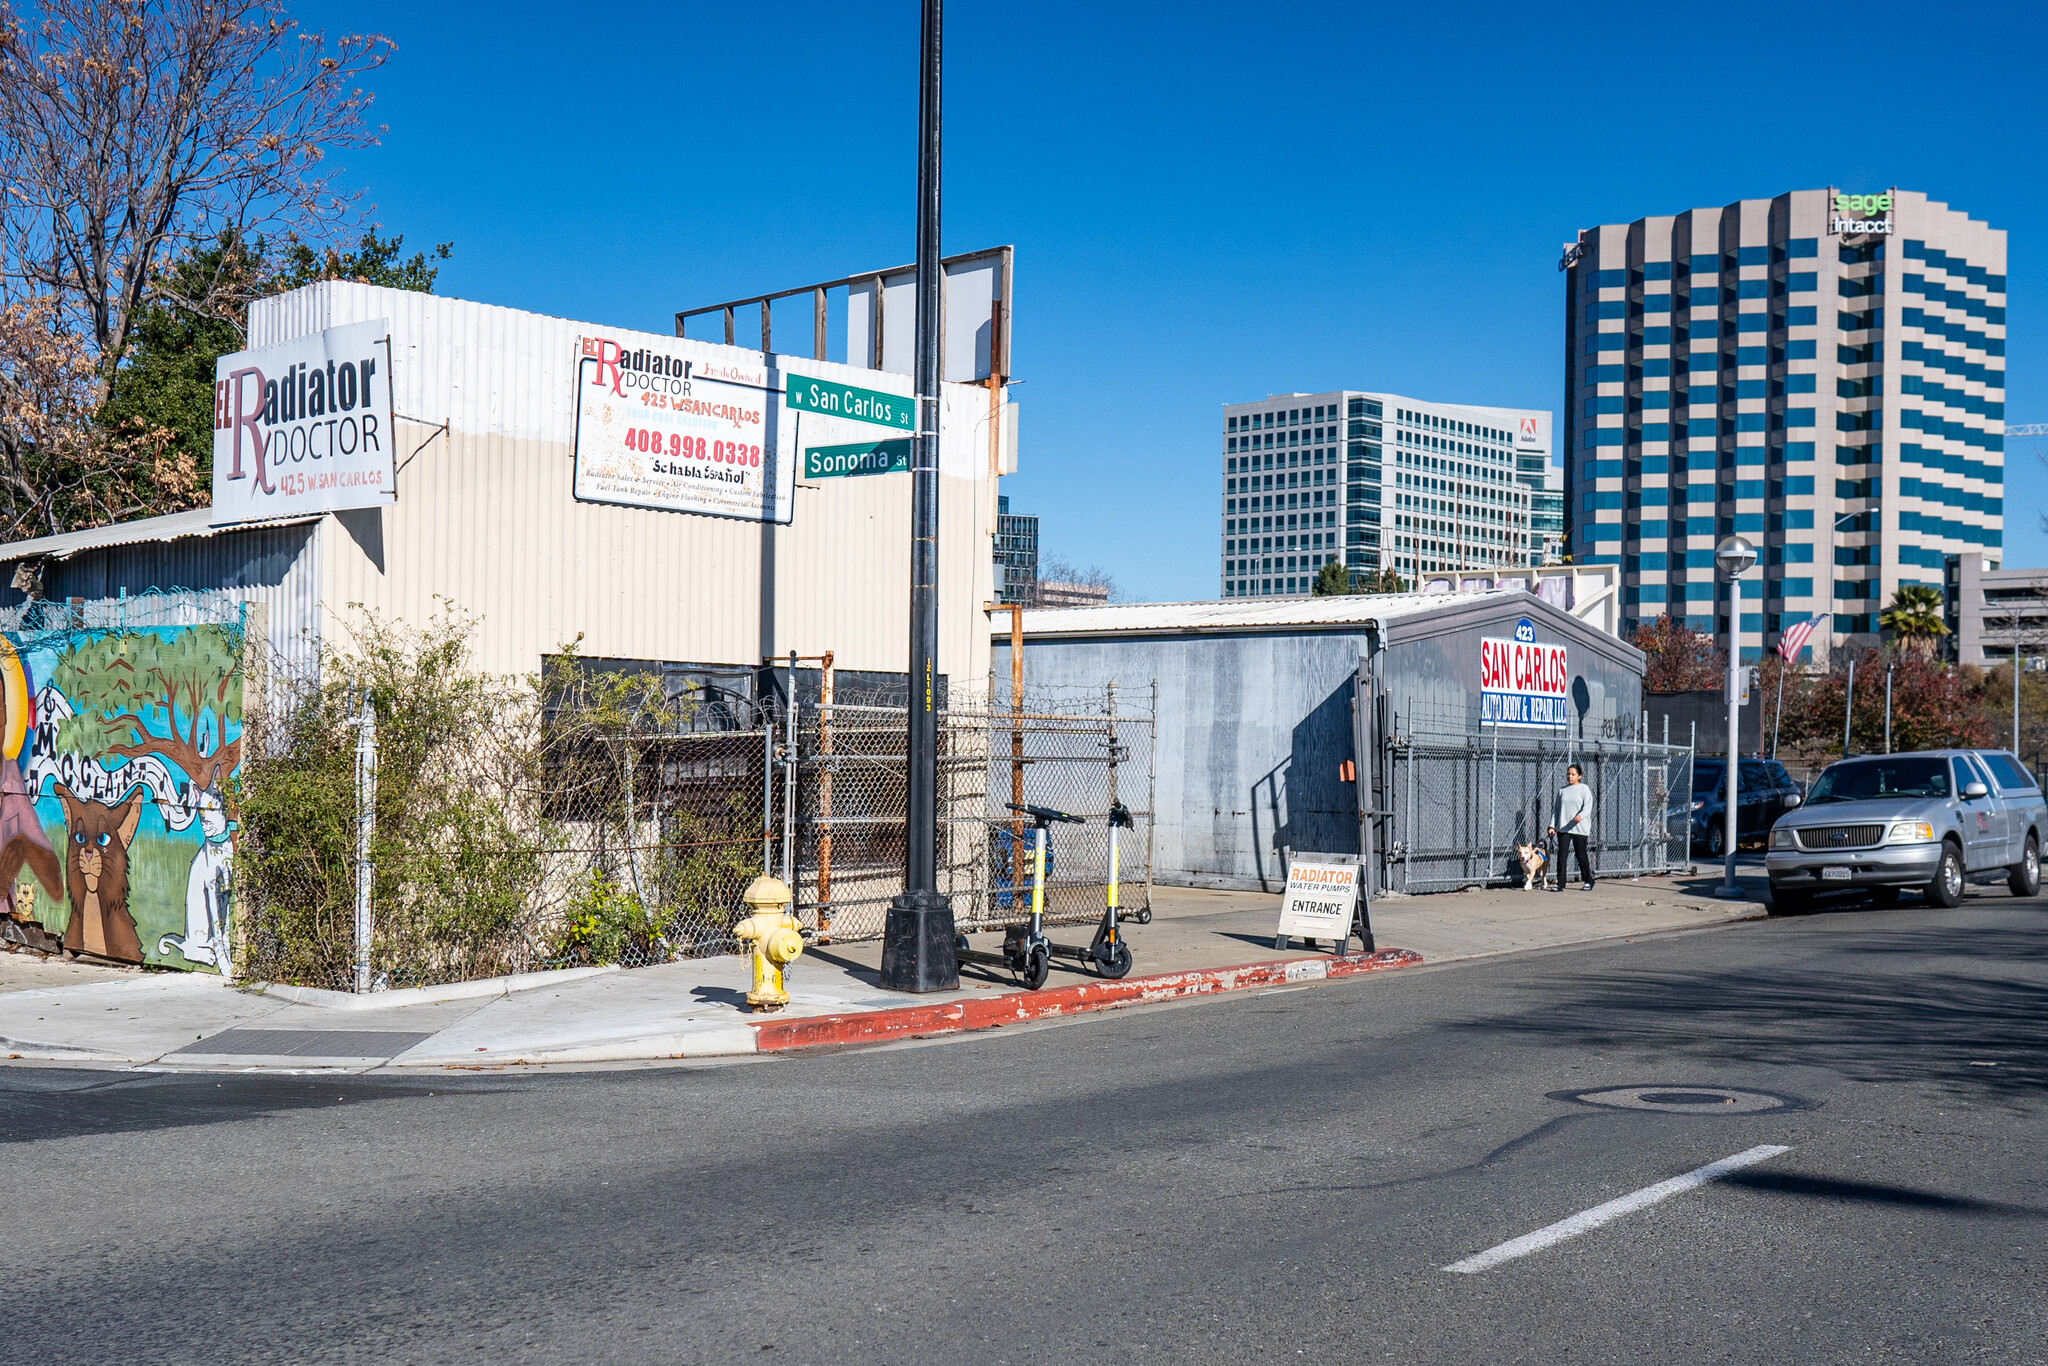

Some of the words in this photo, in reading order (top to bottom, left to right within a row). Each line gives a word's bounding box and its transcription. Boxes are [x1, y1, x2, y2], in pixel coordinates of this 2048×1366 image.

[1836, 194, 1892, 217] sage
[1834, 217, 1892, 233] Intacct
[582, 337, 598, 356] EL
[627, 373, 692, 396] DOCTOR
[215, 379, 232, 430] EL
[641, 392, 667, 409] 425
[795, 391, 802, 404] W
[810, 384, 838, 411] San
[844, 391, 892, 421] Carlos
[900, 412, 908, 425] St
[274, 414, 380, 467] DOCTOR
[624, 427, 760, 468] 408.998.0338
[669, 462, 702, 479] habla
[810, 451, 888, 473] Sonoma
[896, 454, 907, 466] St
[280, 473, 305, 496] 425
[340, 470, 383, 488] CARLOS
[585, 470, 615, 480] Radiator
[617, 474, 633, 482] Sales
[642, 477, 665, 487] Service
[683, 482, 723, 495] Conditioning
[752, 491, 787, 501] Fabrication
[596, 483, 611, 491] Fuel
[613, 485, 628, 493] Tank
[630, 488, 651, 496] Repair
[658, 490, 680, 499] Engine
[680, 495, 707, 504] Flushing
[713, 498, 749, 508] Commercial
[750, 503, 776, 511] Accounts
[1515, 626, 1534, 642] 423
[1482, 641, 1510, 689] SAN
[1515, 645, 1566, 693] CARLOS
[1481, 693, 1502, 720] AUTO
[1502, 695, 1522, 721] BODY
[1522, 696, 1528, 722] &
[1530, 697, 1554, 723] REPAIR
[1290, 882, 1319, 891] WATER
[1321, 884, 1351, 893] PUMPS
[1291, 868, 1353, 885] RADIATOR
[1291, 900, 1343, 915] ENTRANCE
